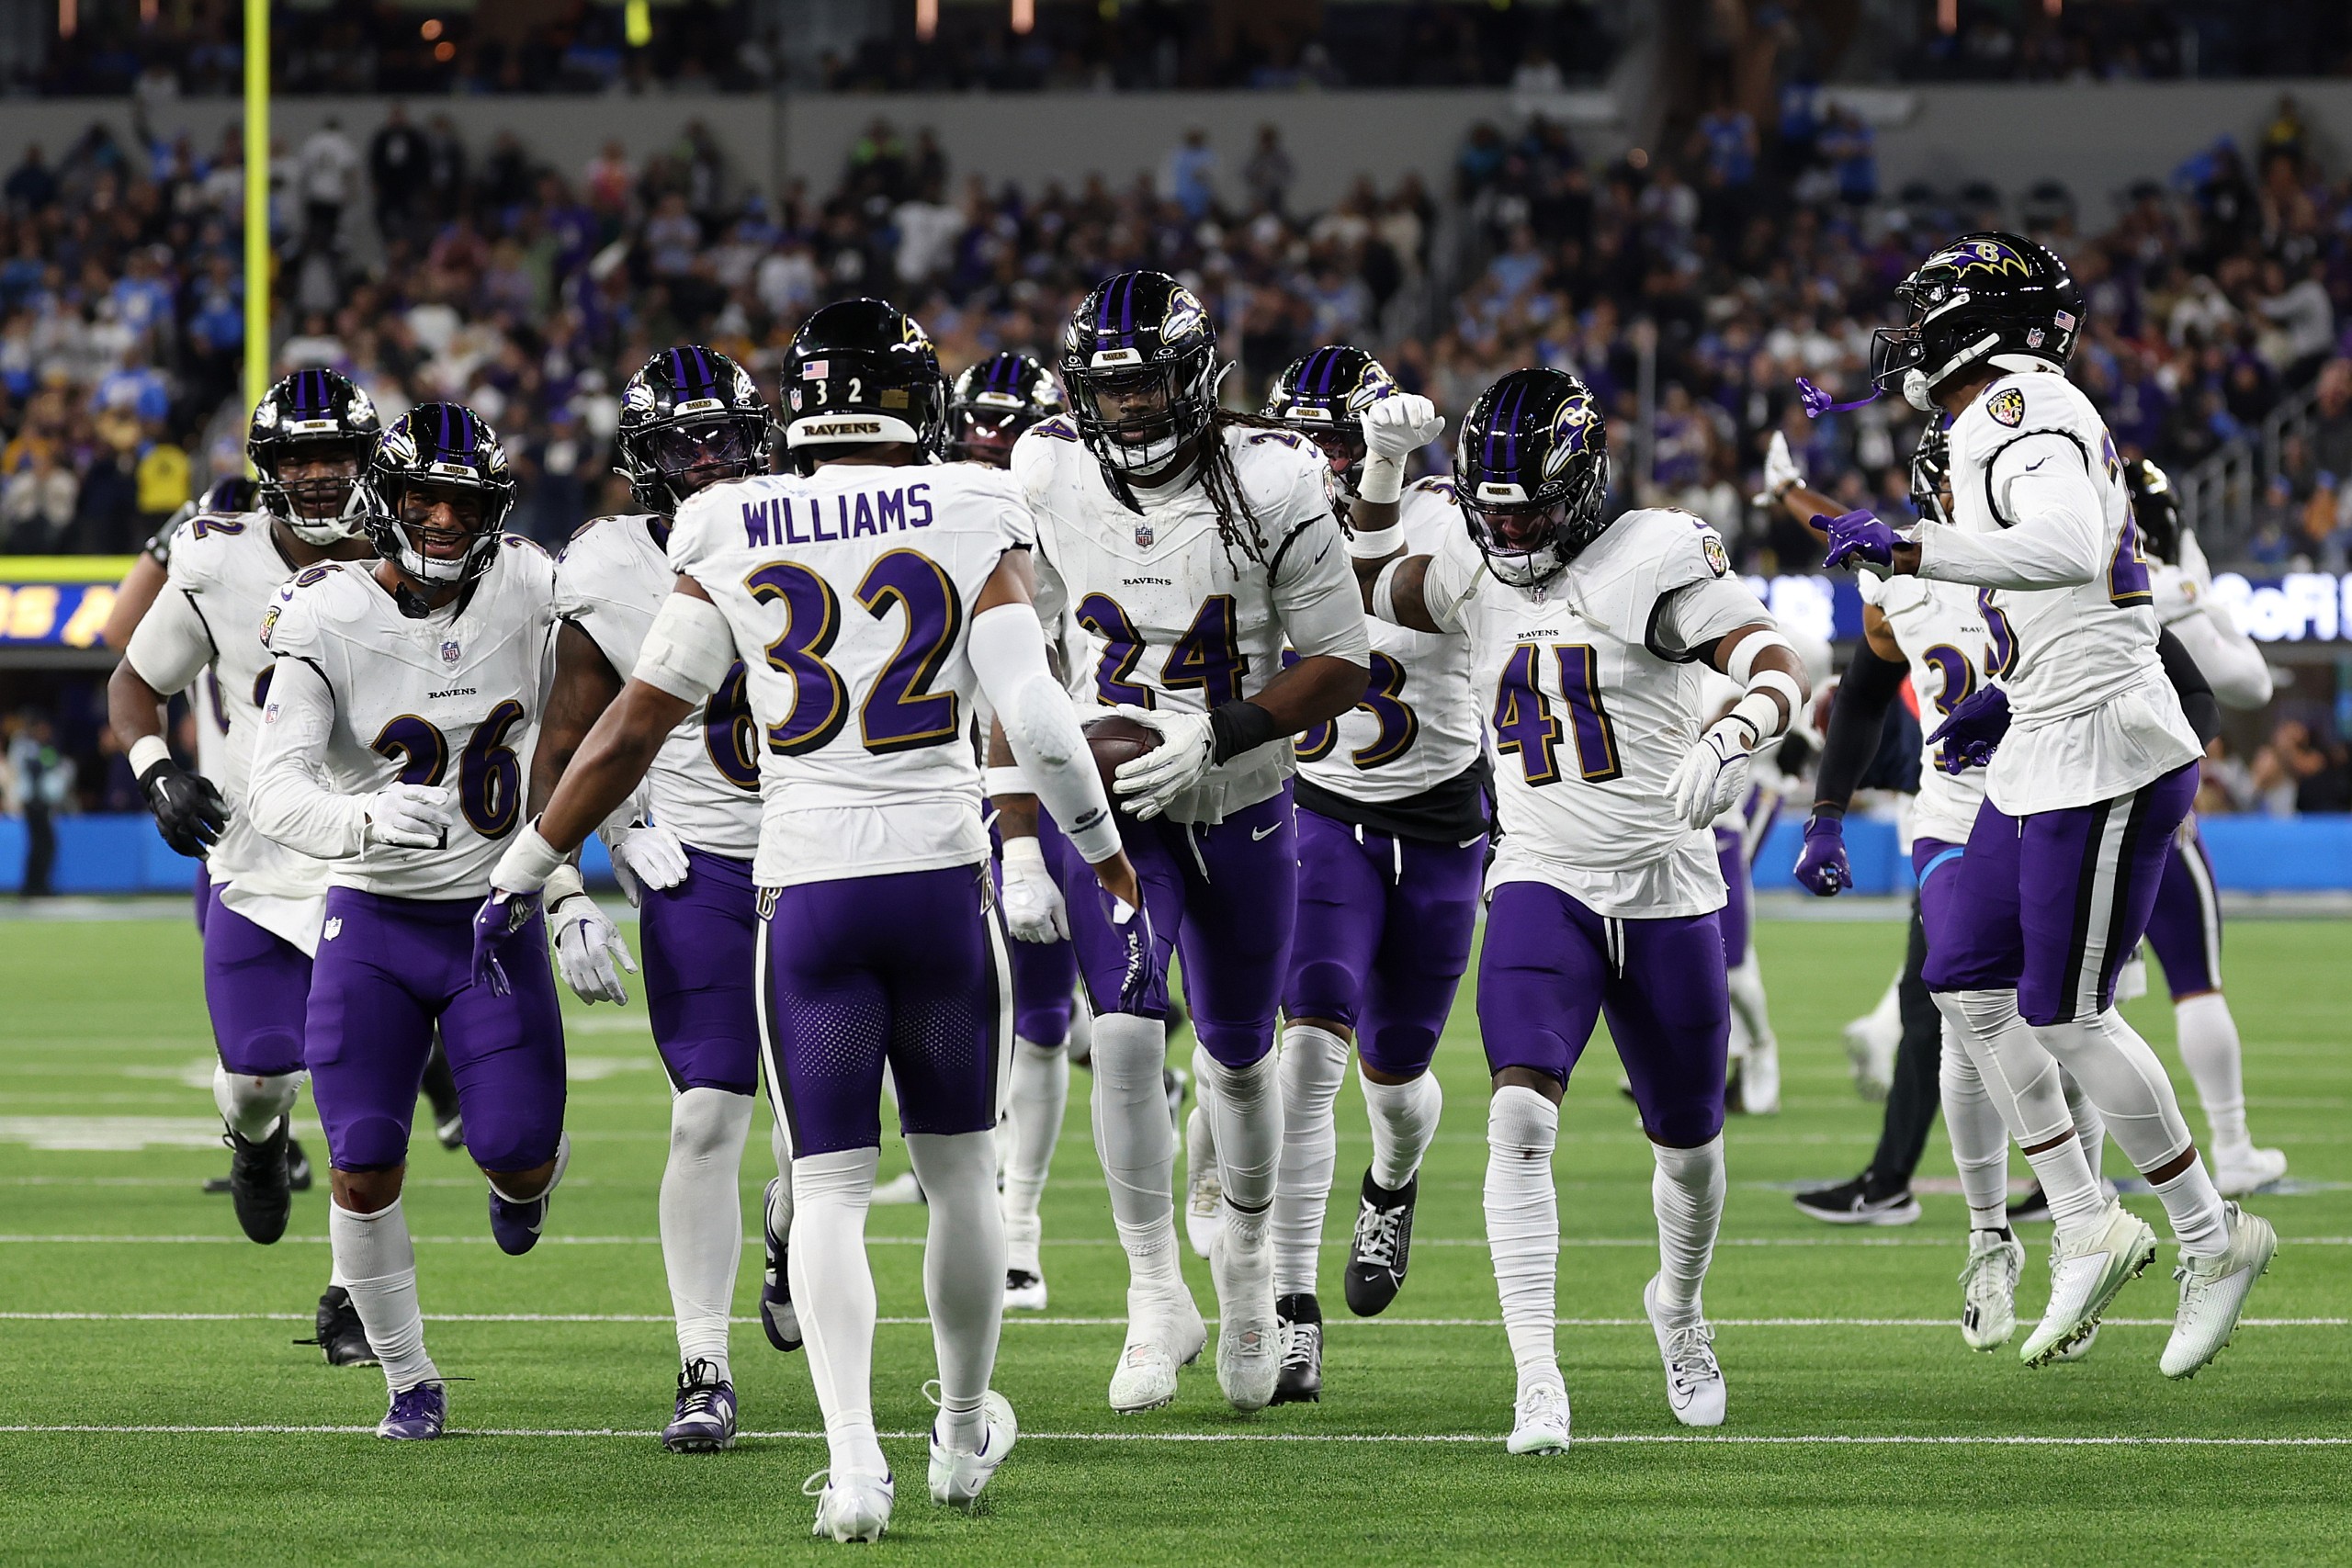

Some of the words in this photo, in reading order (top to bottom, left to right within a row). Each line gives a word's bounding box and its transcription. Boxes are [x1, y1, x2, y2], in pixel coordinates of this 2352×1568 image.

[802, 422, 882, 437] RAVENS
[741, 482, 934, 548] WILLIAMS
[1122, 577, 1172, 586] RAVENS
[1517, 628, 1560, 639] RAVENS
[1959, 626, 1985, 634] RAV
[742, 547, 962, 757] 32
[427, 687, 478, 699] RAVENS
[1493, 642, 1624, 788] 41
